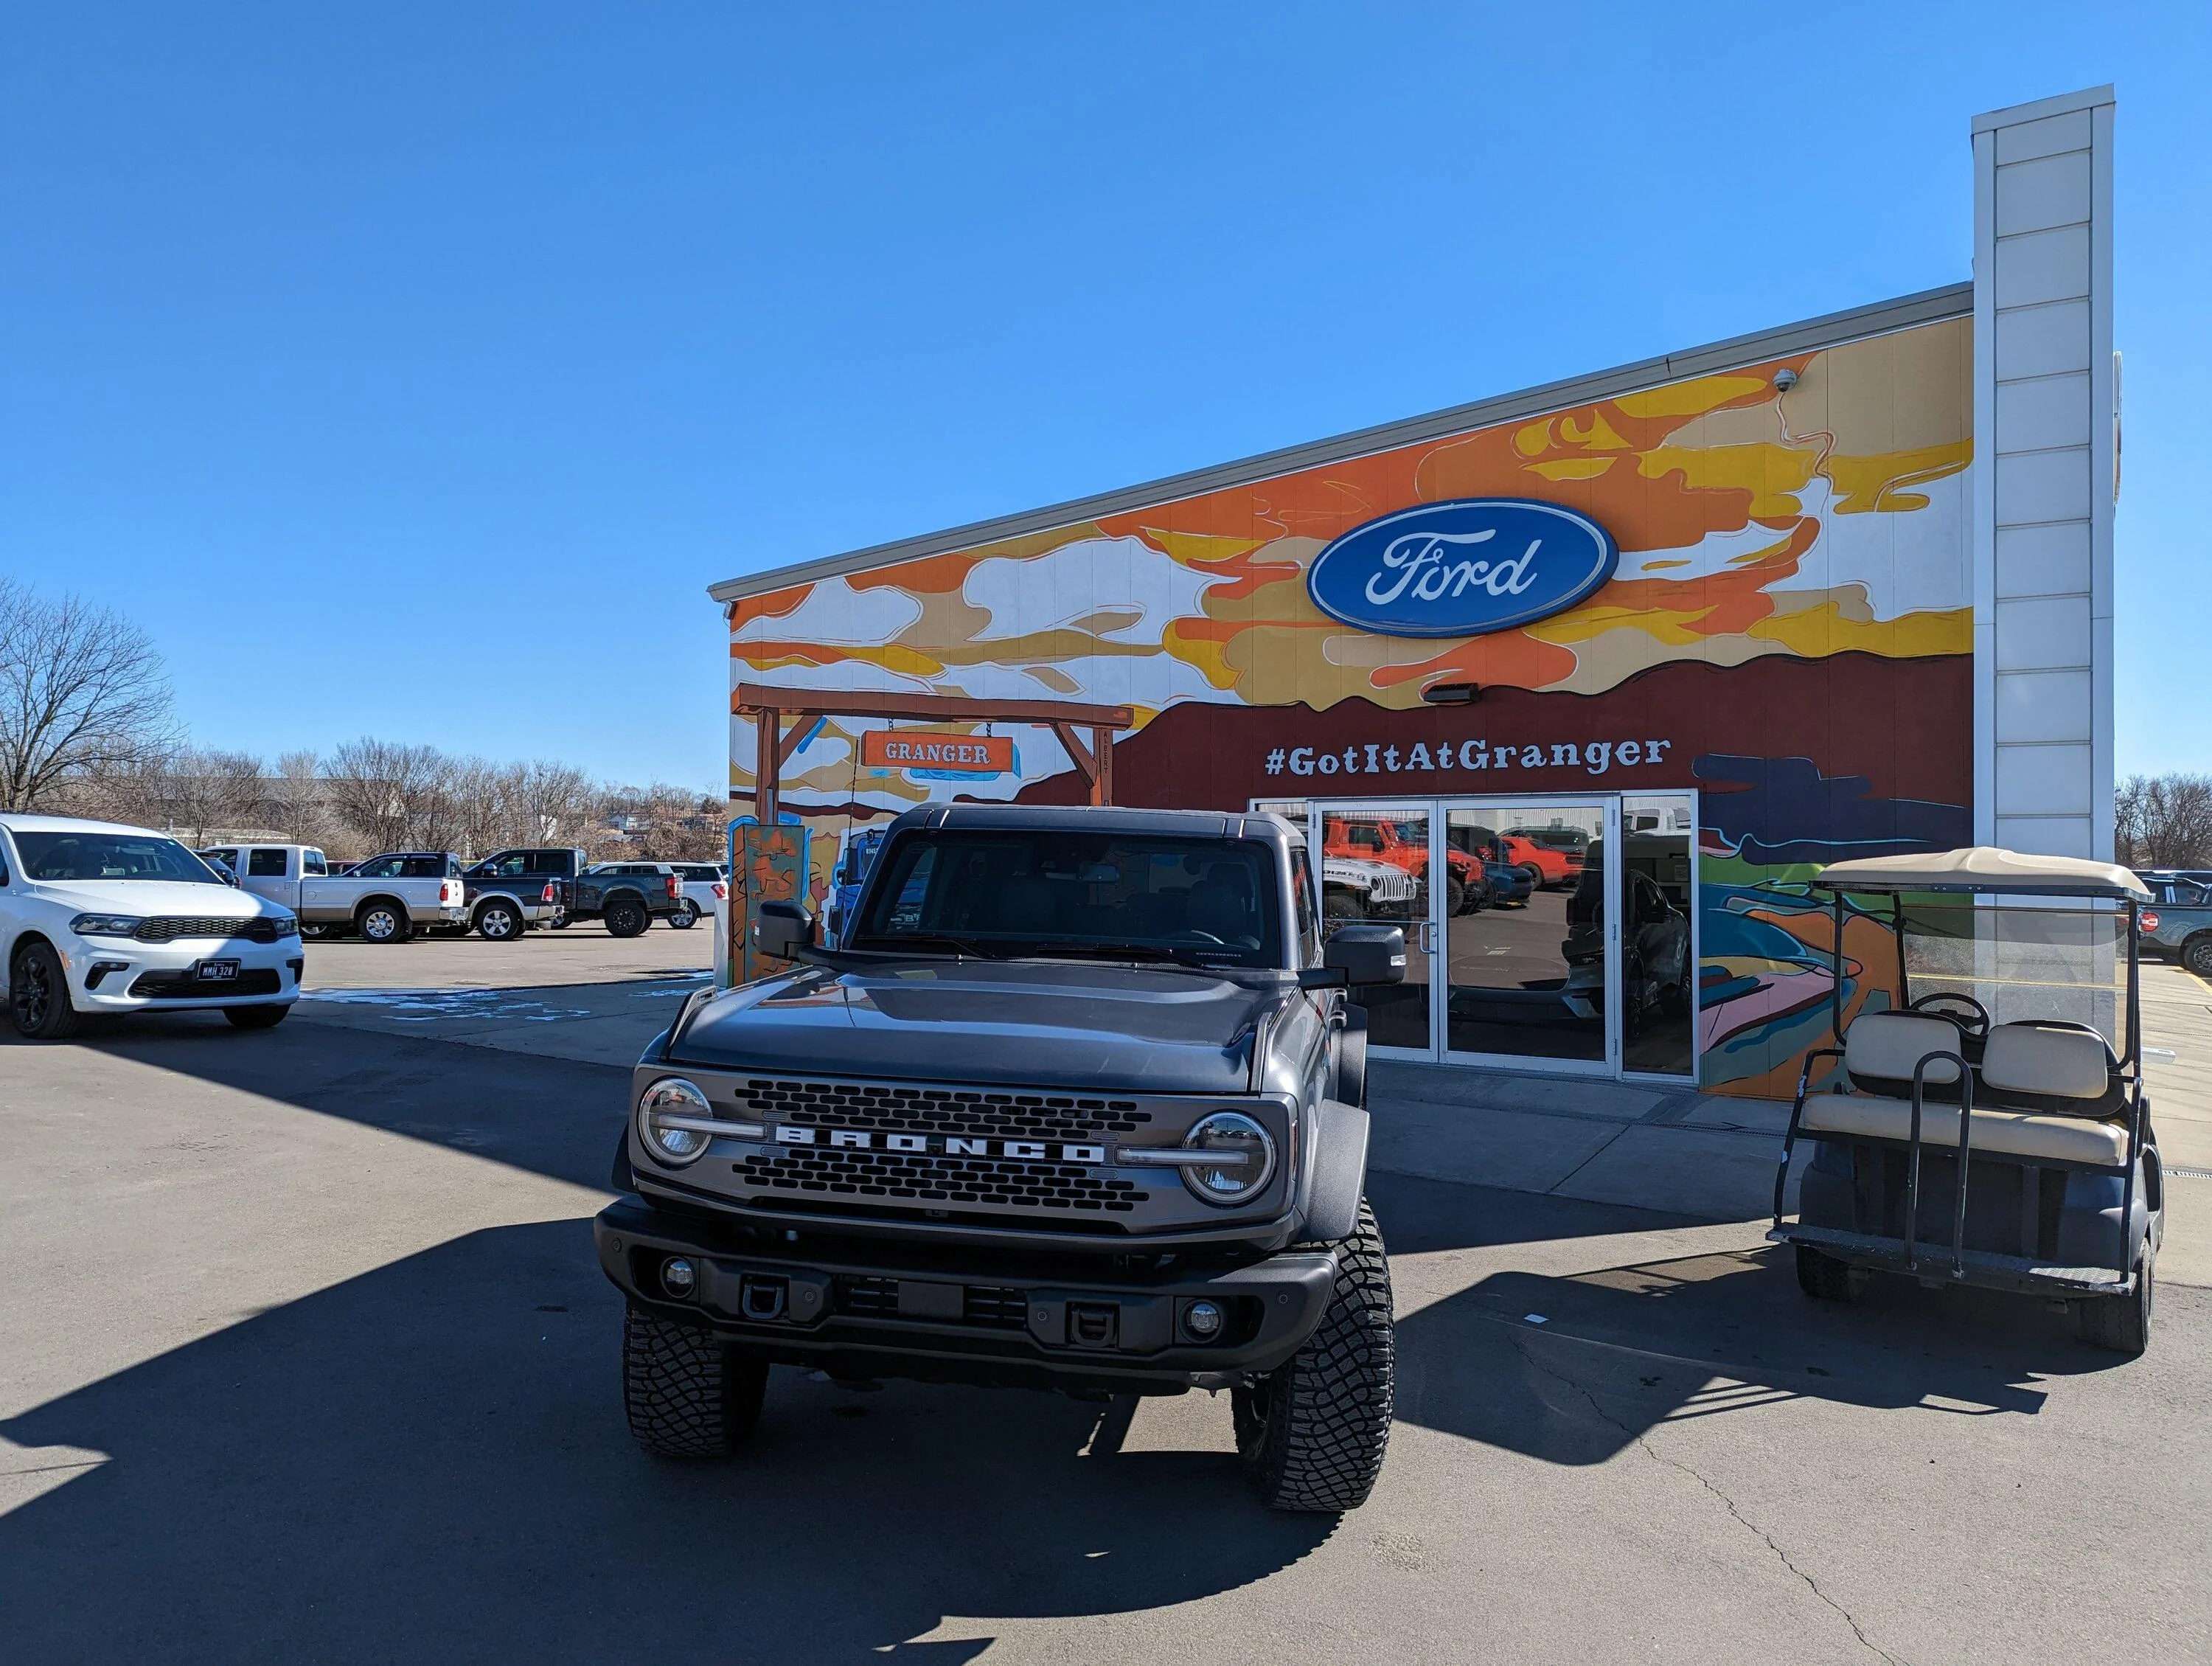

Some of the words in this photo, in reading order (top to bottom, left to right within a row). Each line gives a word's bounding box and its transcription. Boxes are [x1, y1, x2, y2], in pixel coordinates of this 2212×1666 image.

[1366, 529, 1543, 605] Ford
[886, 743, 991, 765] GRANGER
[1264, 739, 1672, 776] #GotItAtGranger
[776, 1126, 1103, 1163] BRONCO
